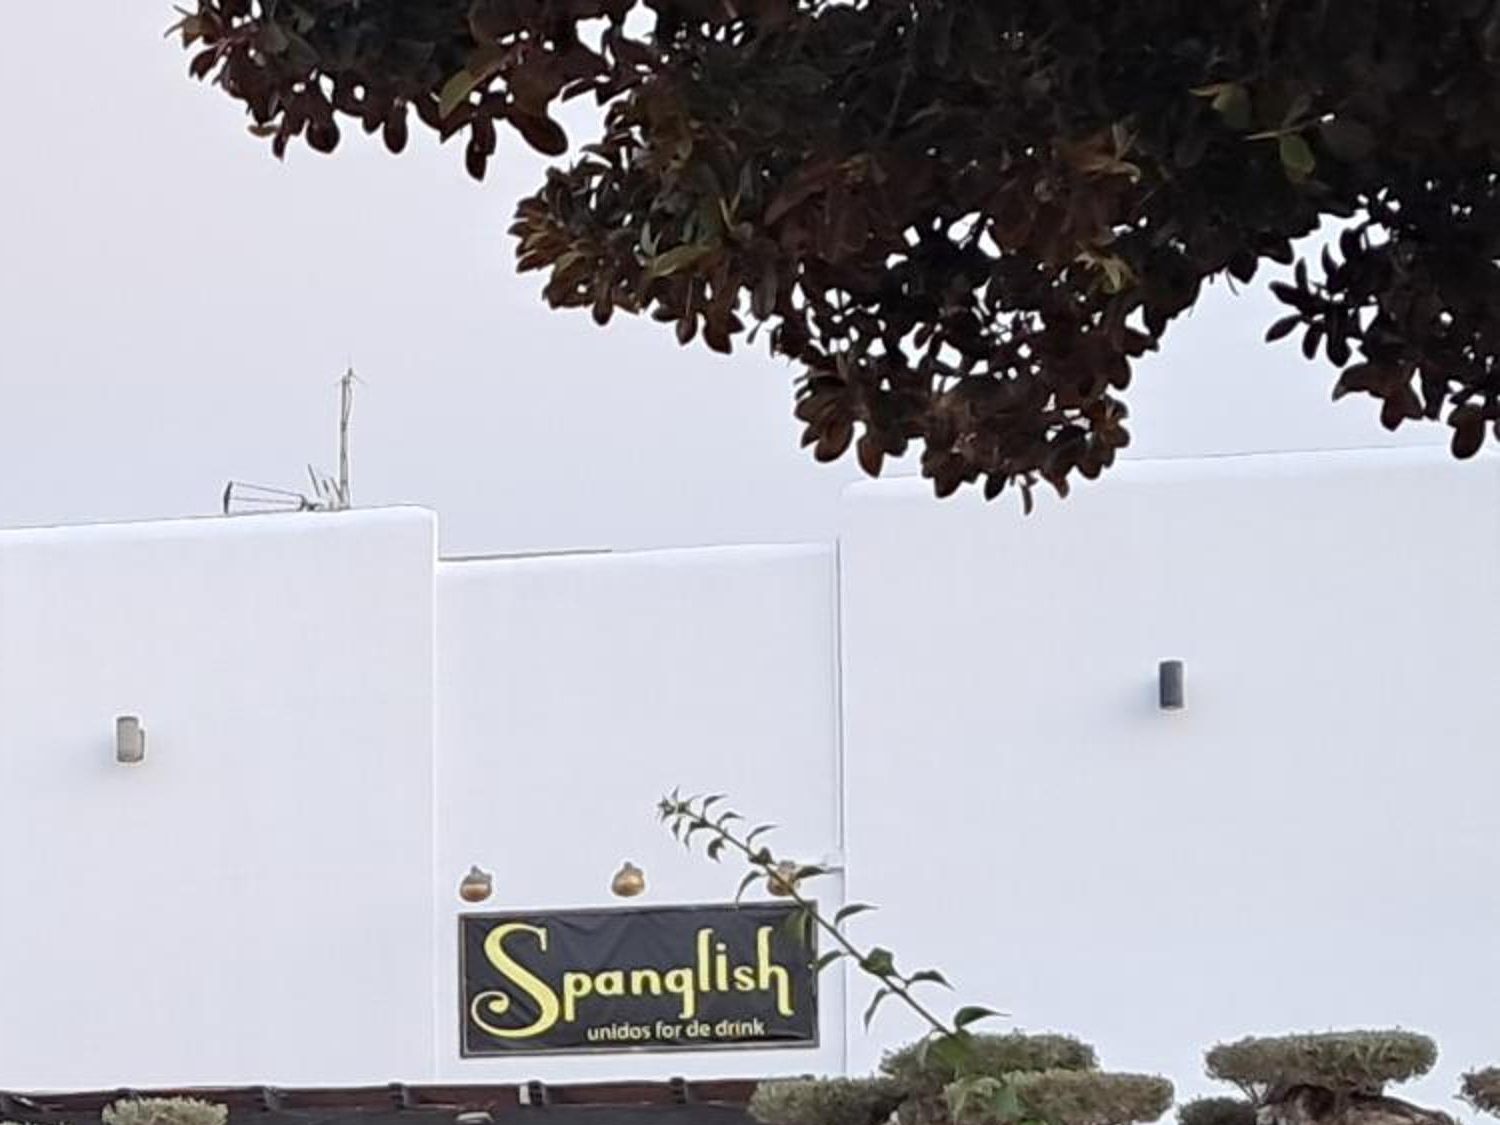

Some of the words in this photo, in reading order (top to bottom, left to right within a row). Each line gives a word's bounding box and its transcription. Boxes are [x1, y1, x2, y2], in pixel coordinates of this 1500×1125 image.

[471, 922, 794, 1038] Spanglish
[587, 1023, 650, 1041] unidos
[655, 1020, 681, 1039] for
[686, 1019, 710, 1037] de
[715, 1017, 765, 1036] drink
